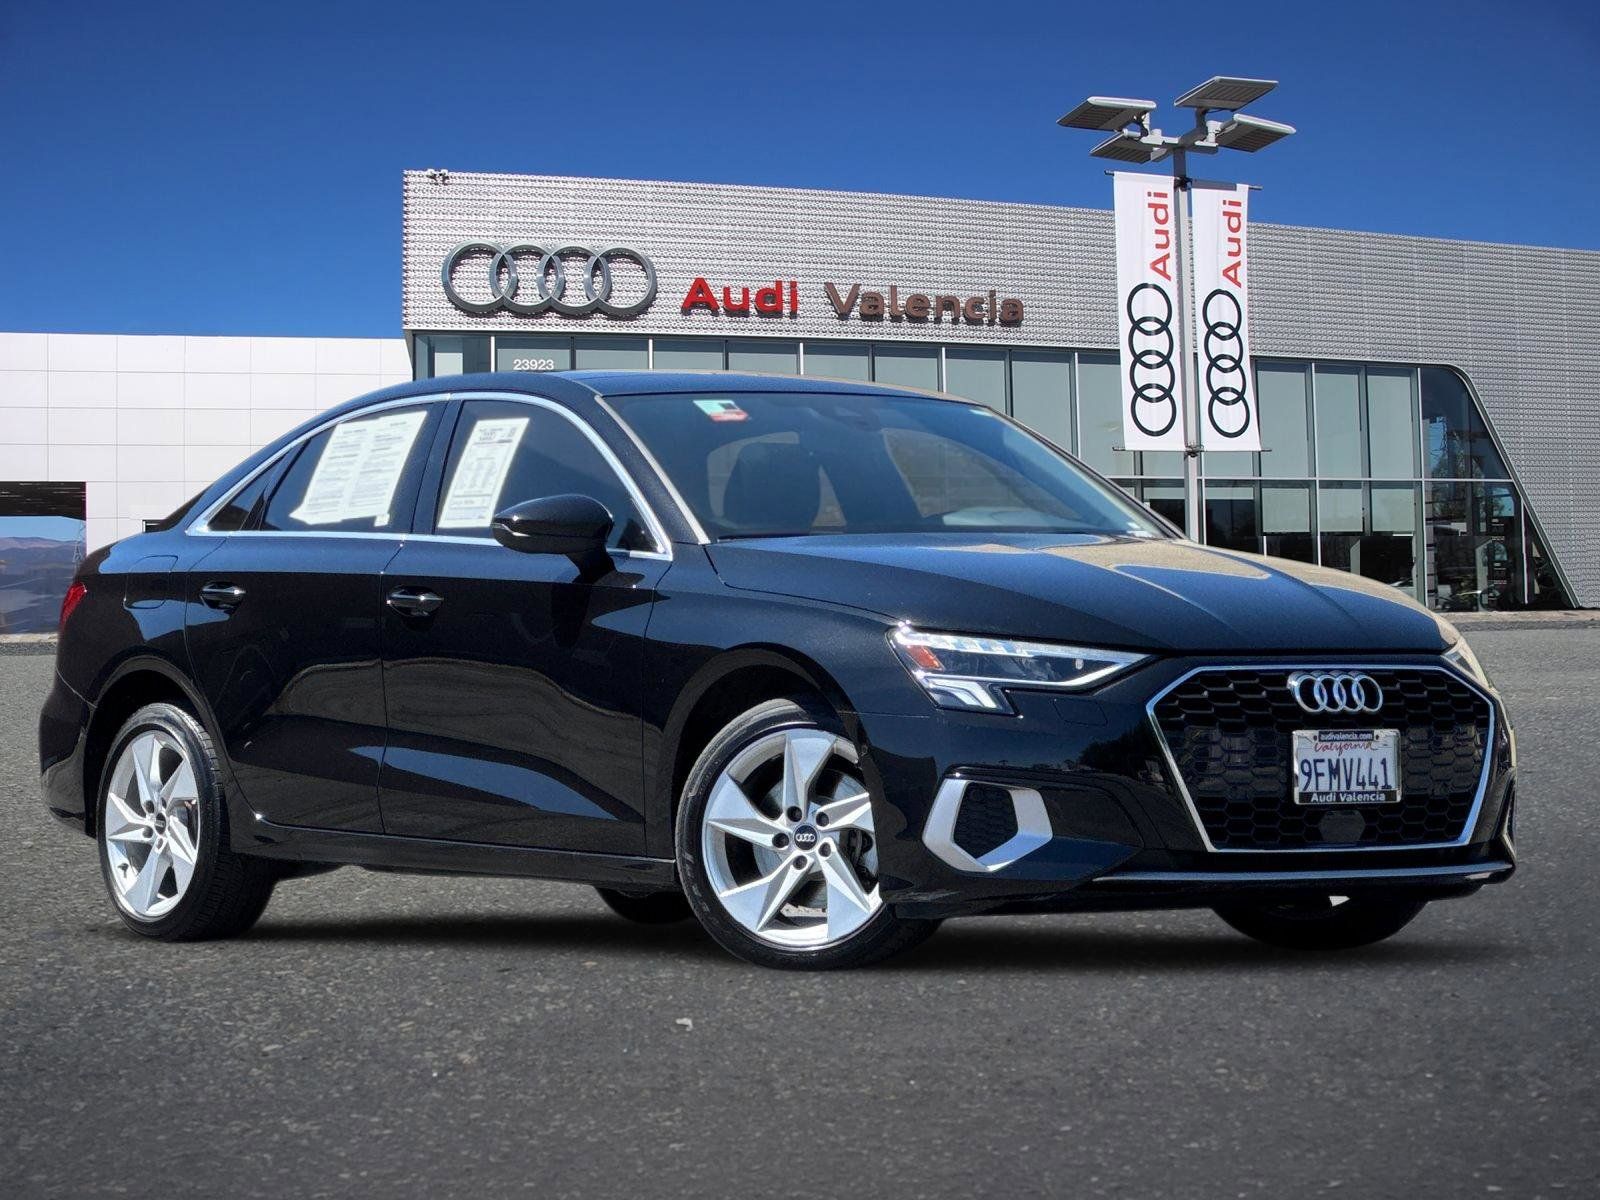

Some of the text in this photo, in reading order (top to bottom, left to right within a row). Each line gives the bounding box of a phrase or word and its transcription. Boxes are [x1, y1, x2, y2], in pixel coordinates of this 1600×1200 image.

[1148, 191, 1172, 282] Audi
[1222, 200, 1242, 289] Audi
[681, 277, 1024, 326] Audi Valencia
[513, 359, 554, 371] 23923
[1300, 757, 1392, 791] 9FMV441
[1311, 792, 1386, 802] Audi Valencia
